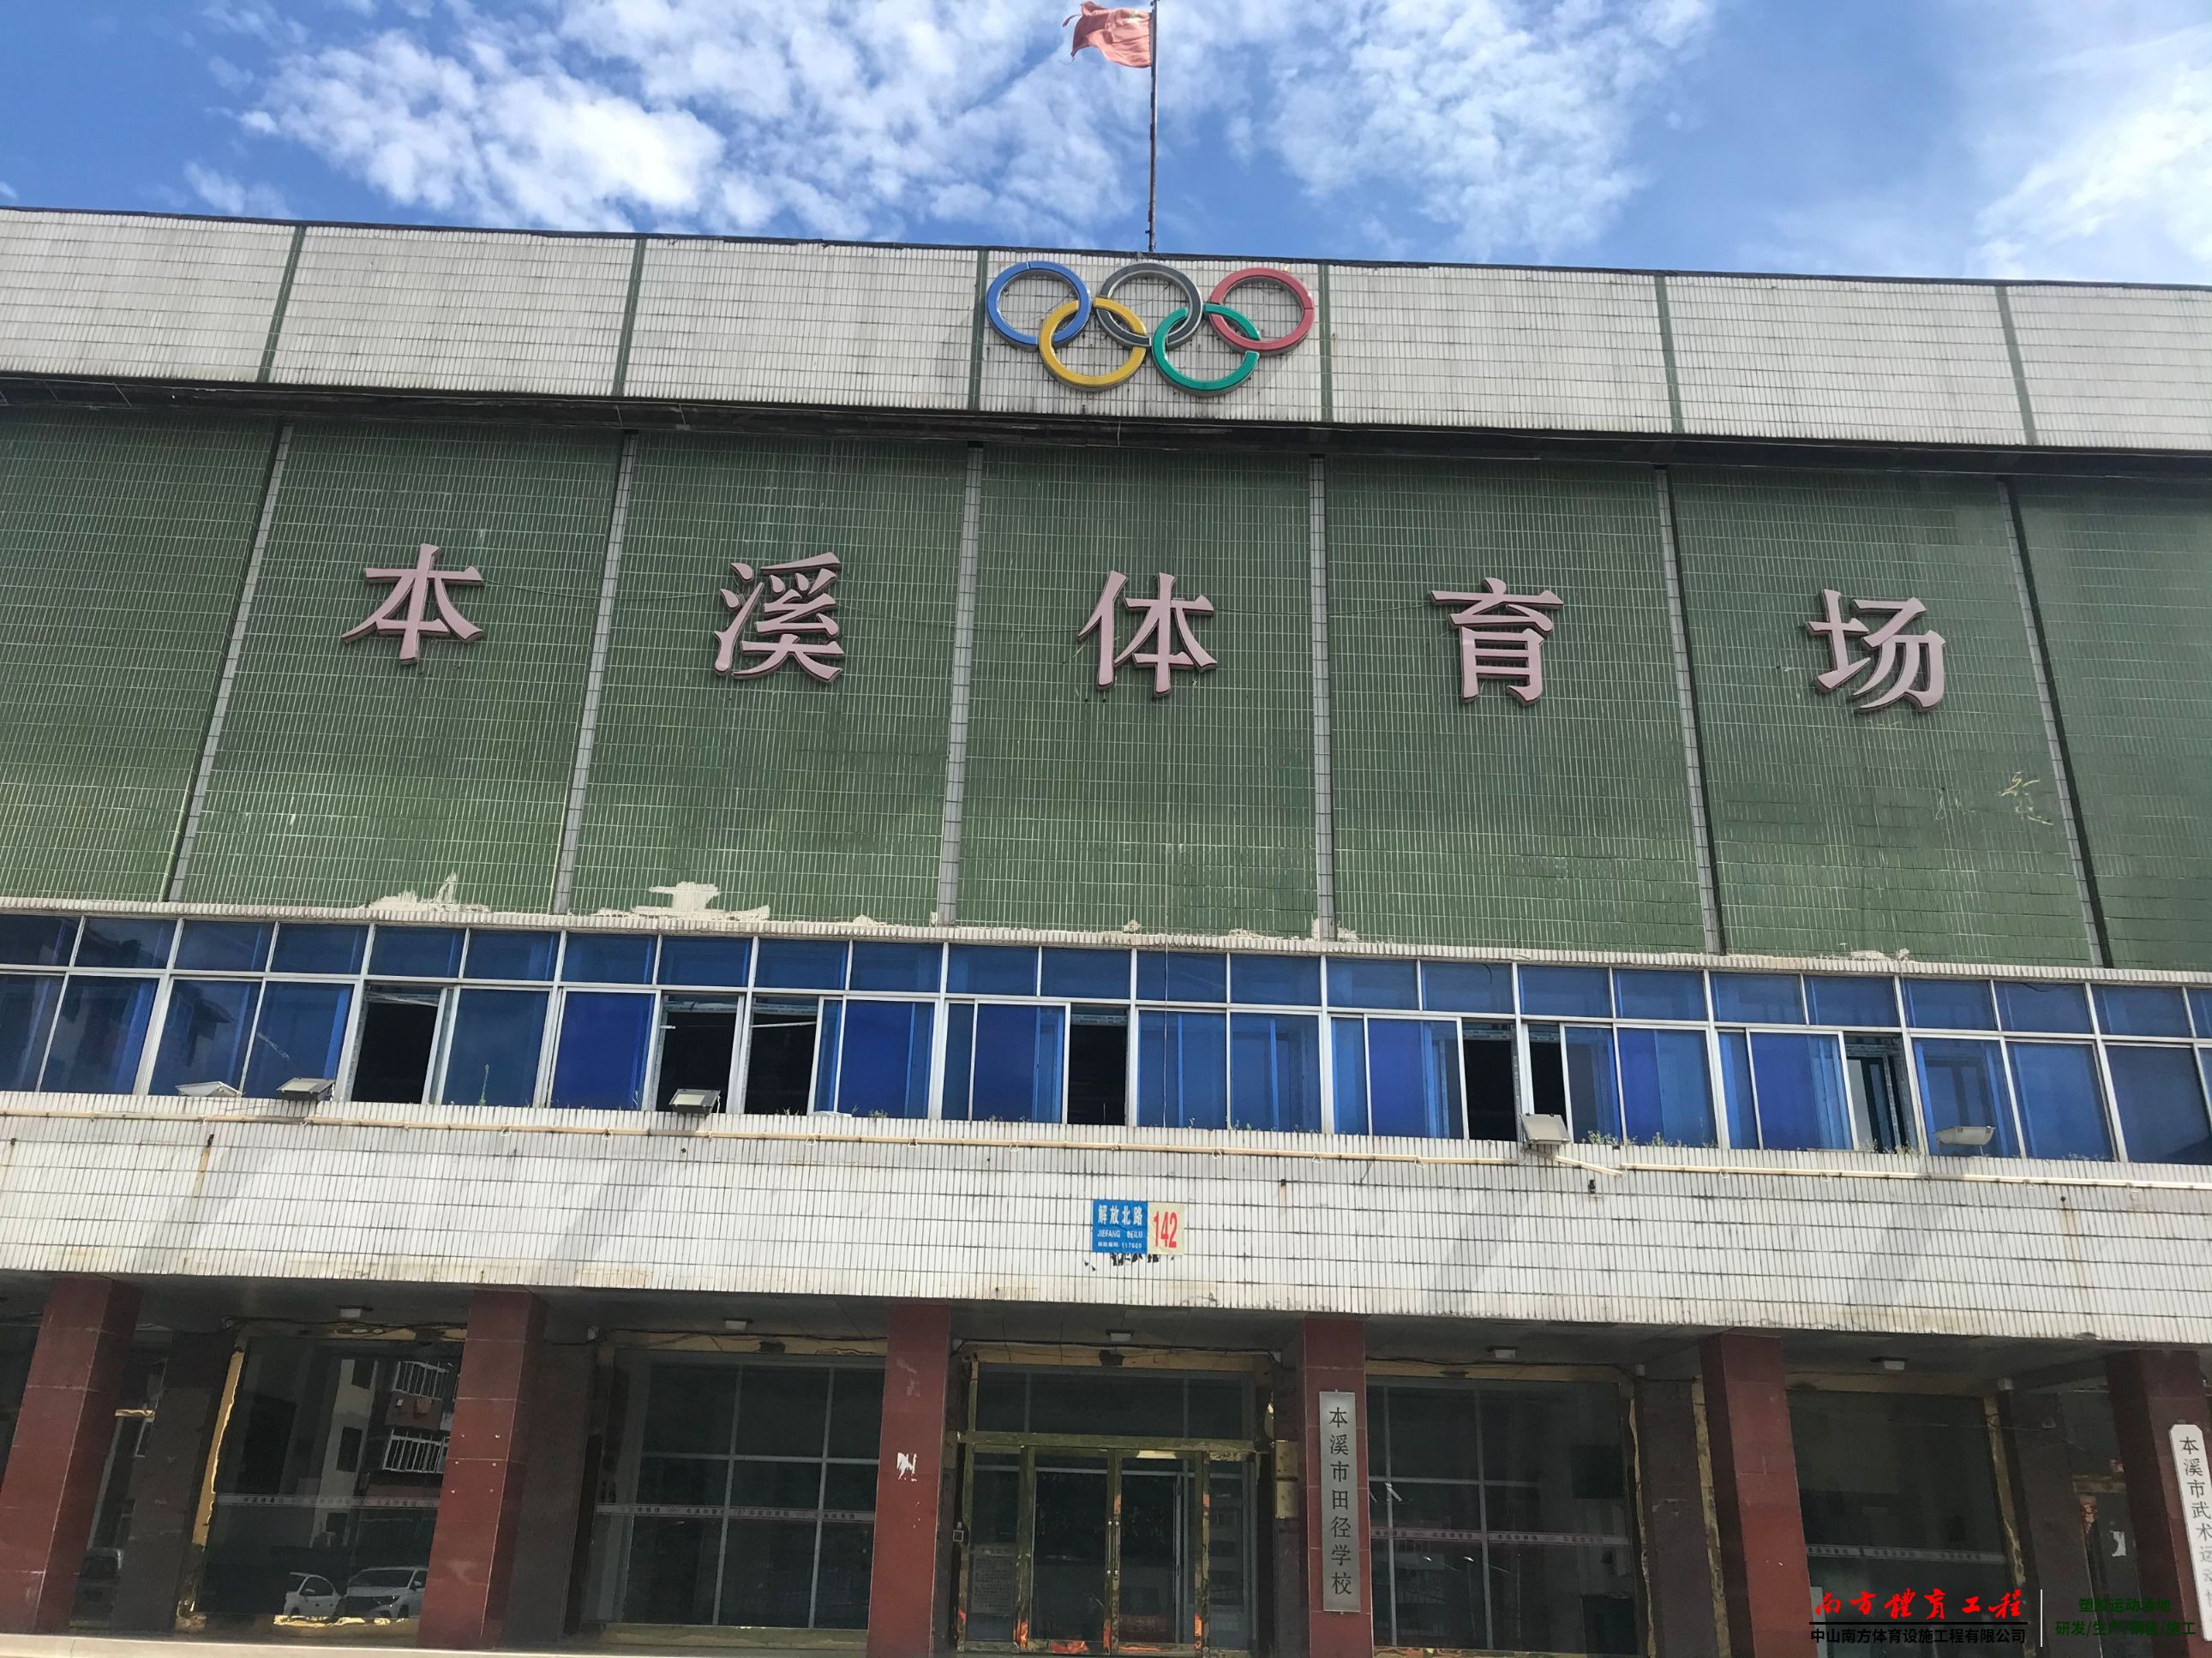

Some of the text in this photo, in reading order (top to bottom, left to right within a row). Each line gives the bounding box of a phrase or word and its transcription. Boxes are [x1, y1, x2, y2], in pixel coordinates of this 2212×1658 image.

[343, 543, 1948, 714] 本溪体育场
[1098, 1205, 1142, 1226] 解放北路
[1154, 1211, 1178, 1248] 142
[1329, 1407, 1352, 1595] 本溪市田径学校
